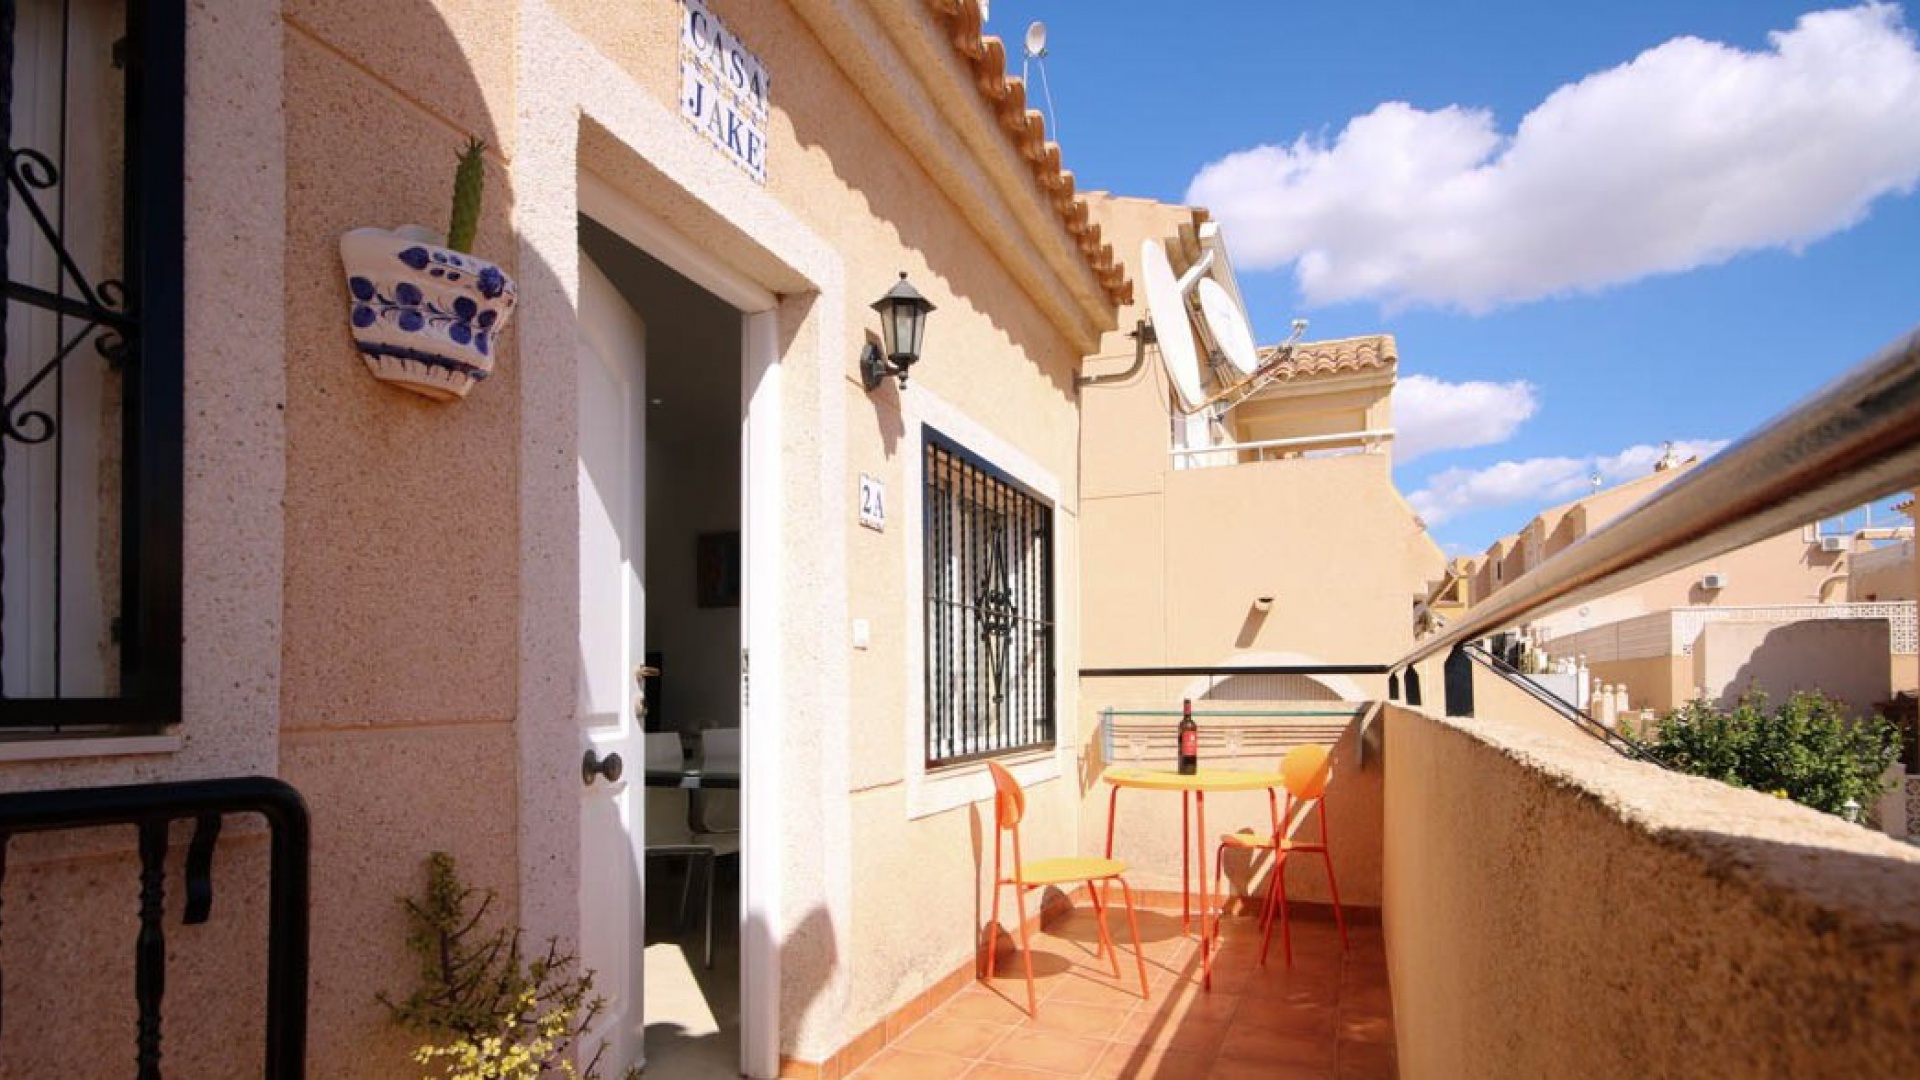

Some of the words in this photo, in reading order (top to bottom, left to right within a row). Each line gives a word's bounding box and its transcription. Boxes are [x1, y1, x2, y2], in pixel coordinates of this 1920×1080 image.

[690, 10, 764, 112] CASA
[689, 80, 761, 172] JAKE
[863, 484, 885, 519] 2A
